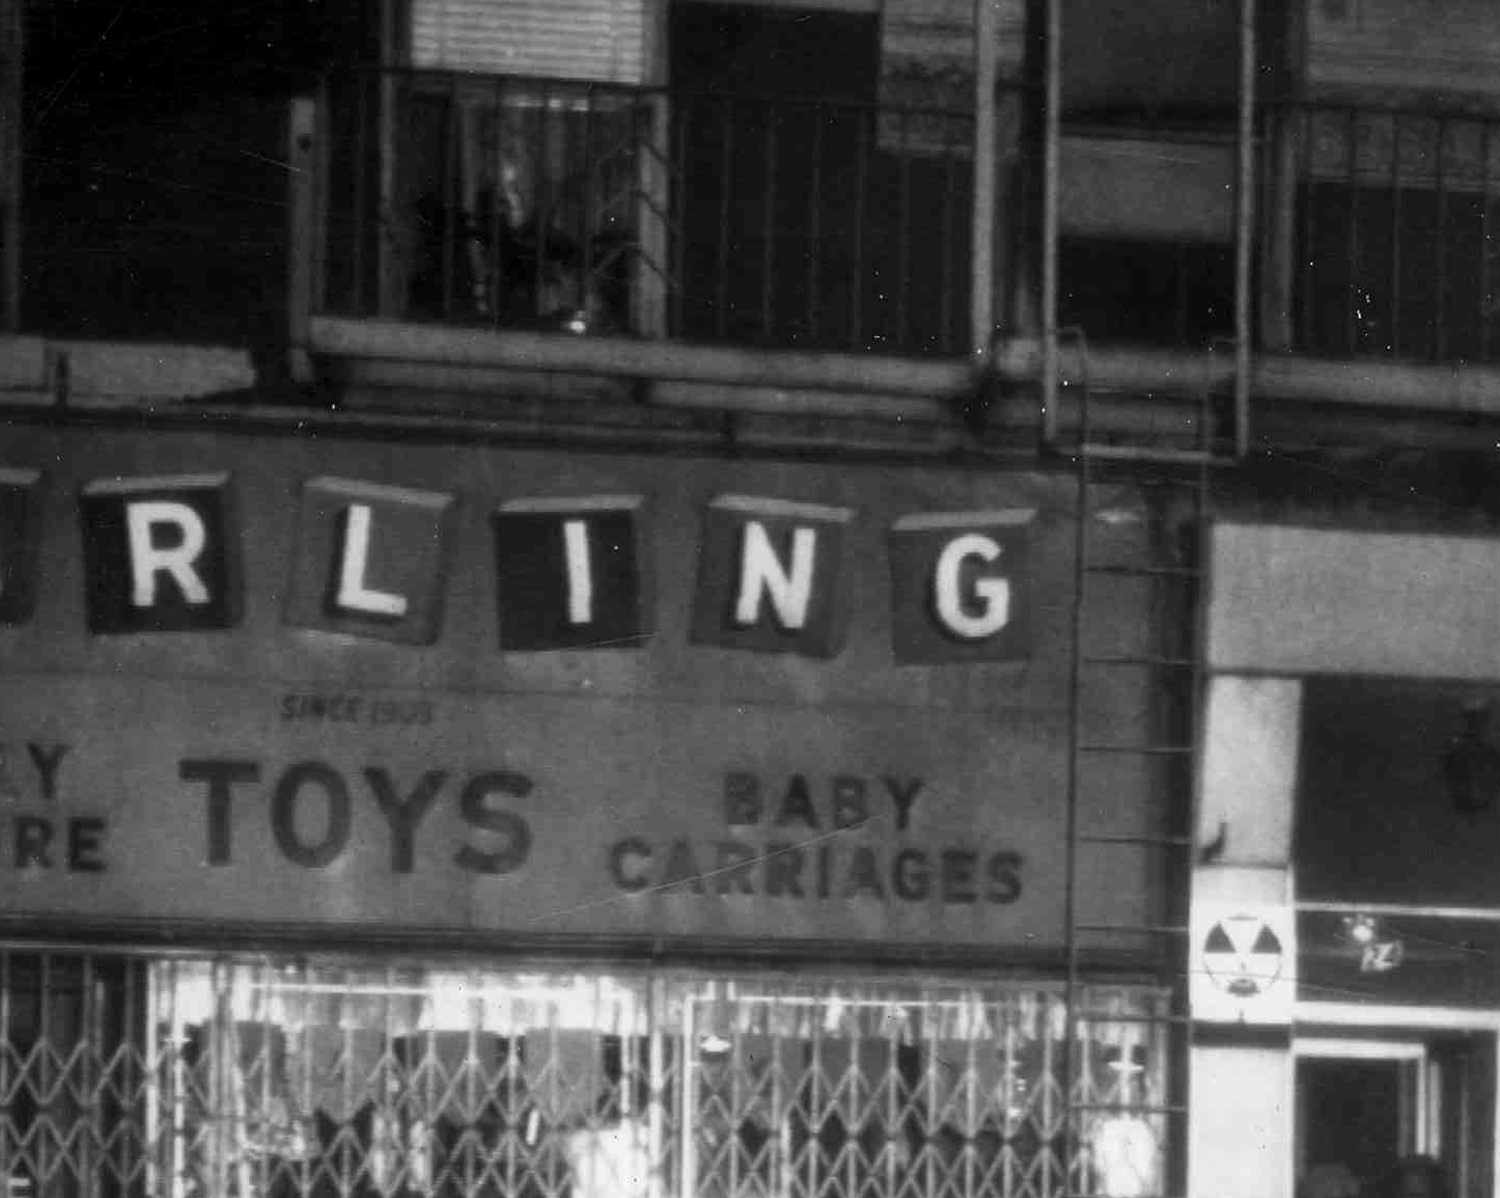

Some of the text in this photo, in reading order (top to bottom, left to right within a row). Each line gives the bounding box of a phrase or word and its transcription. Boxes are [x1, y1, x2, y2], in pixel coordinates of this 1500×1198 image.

[178, 759, 534, 874] TOYS
[723, 771, 926, 831] BABY
[609, 836, 1024, 905] CARRIAGES
